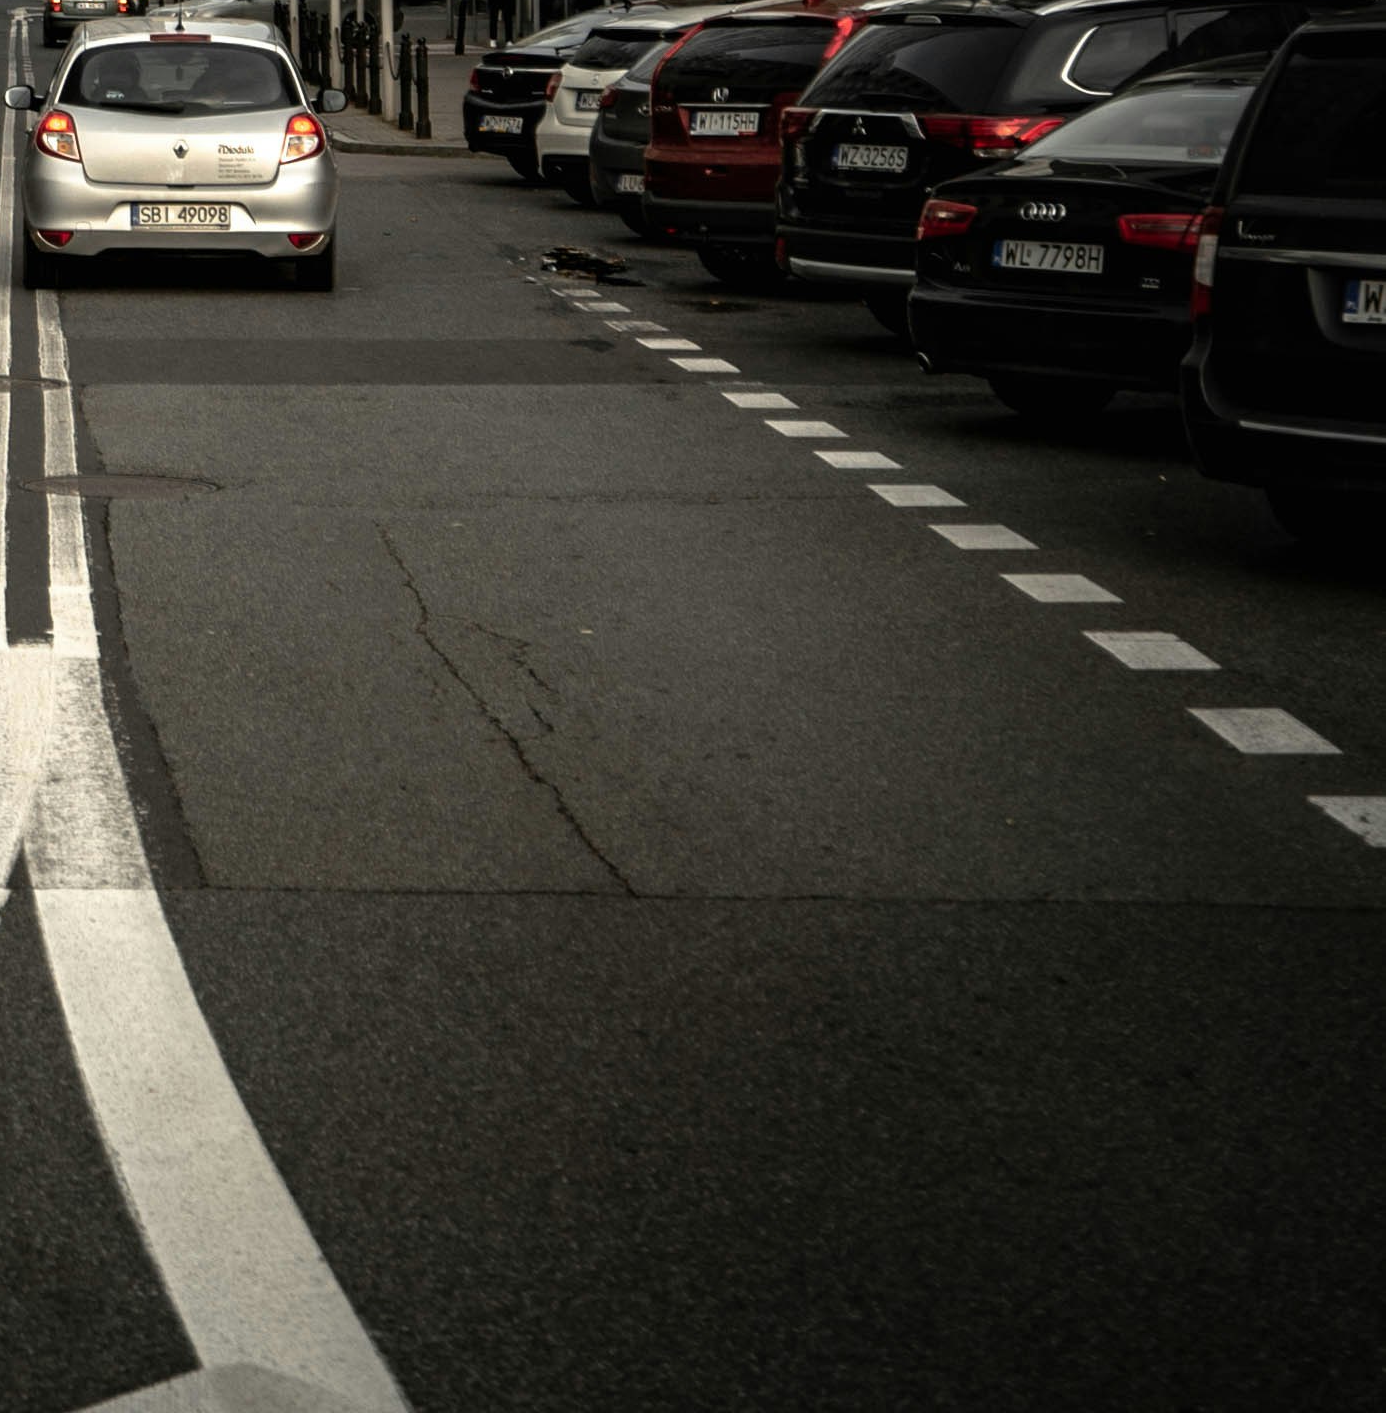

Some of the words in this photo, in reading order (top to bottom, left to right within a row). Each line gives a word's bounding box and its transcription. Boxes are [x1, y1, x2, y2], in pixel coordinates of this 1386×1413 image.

[699, 114, 712, 130] WI
[719, 114, 756, 130] 115HH
[840, 145, 859, 165] WZ
[863, 147, 906, 167] 3256S
[141, 206, 169, 223] SBI
[178, 206, 228, 223] 49098
[1005, 242, 1030, 266] WL
[1038, 244, 1102, 271] 7798H
[1365, 283, 1386, 313] W
